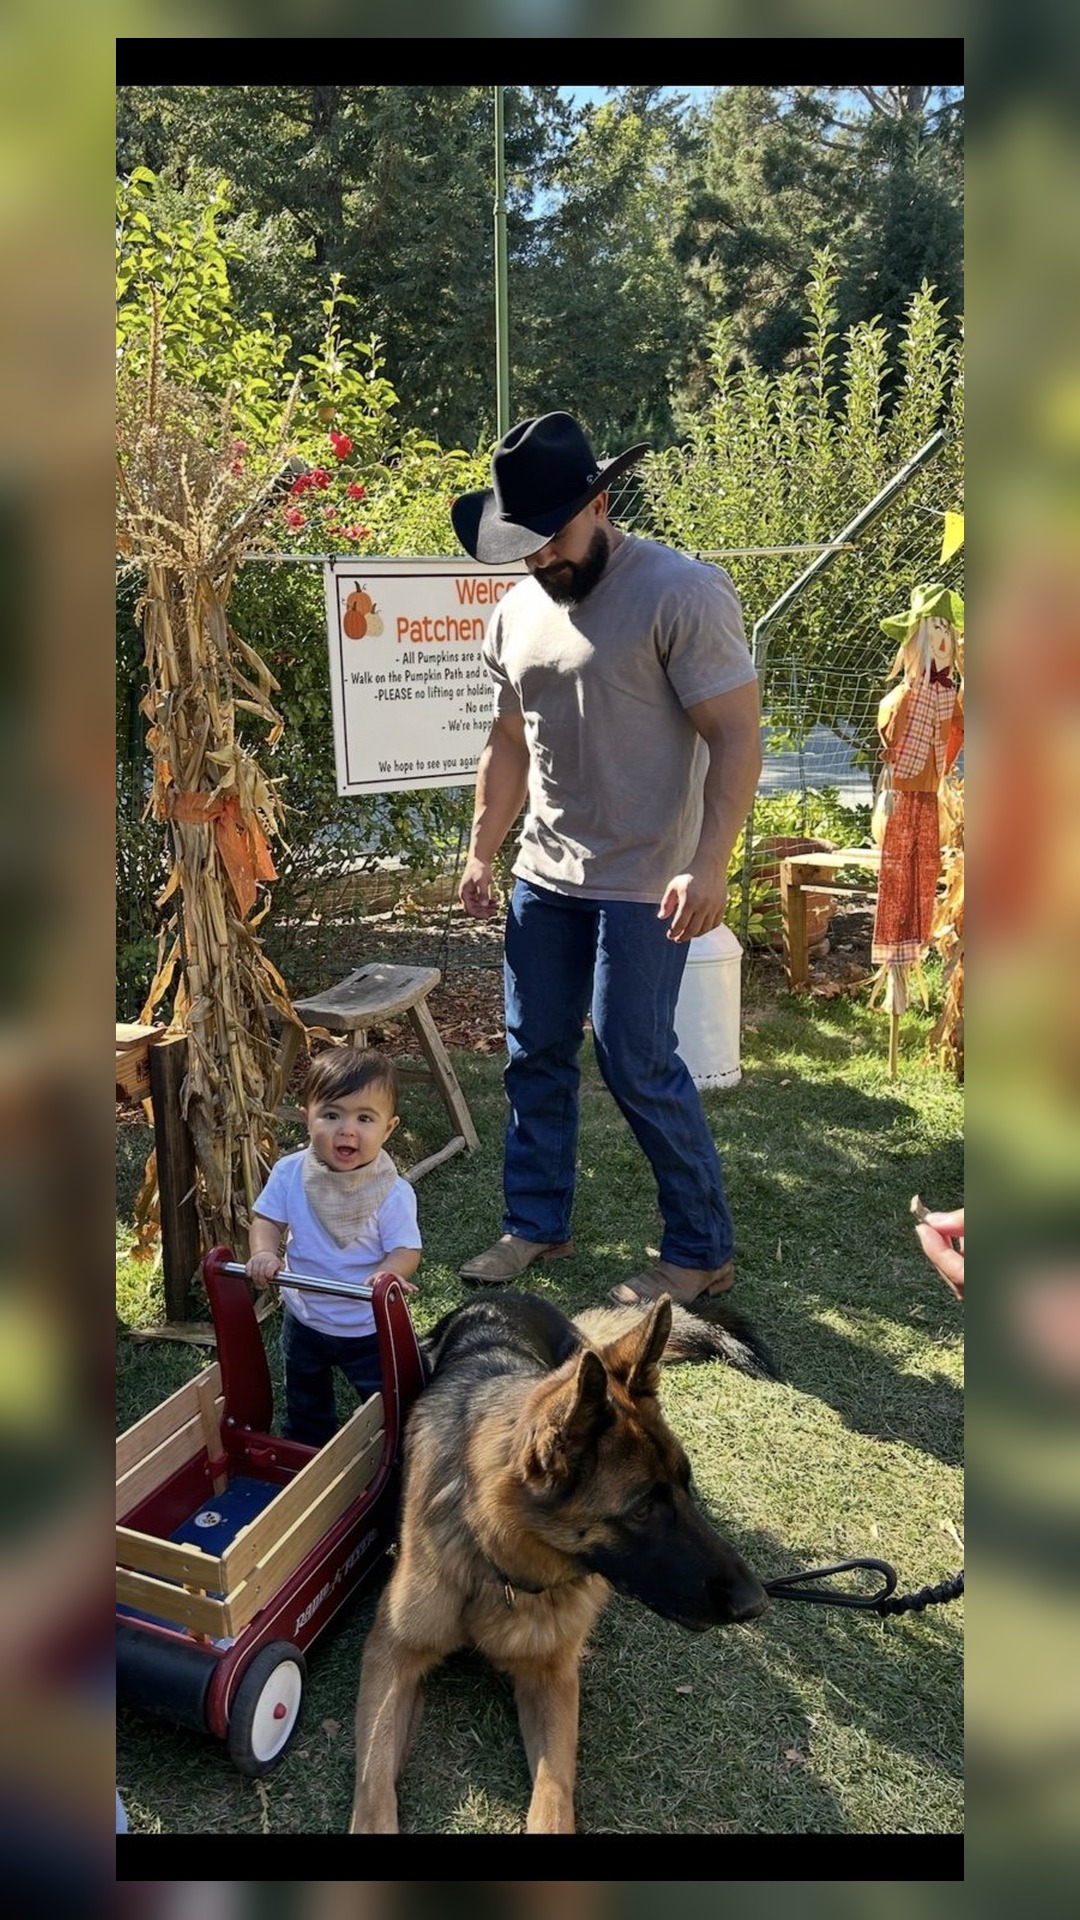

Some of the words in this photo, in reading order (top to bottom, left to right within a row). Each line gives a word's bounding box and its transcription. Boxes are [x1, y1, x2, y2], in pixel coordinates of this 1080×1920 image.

[396, 615, 485, 643] Patchen
[402, 651, 415, 664] All
[418, 650, 459, 666] Pumpkins
[461, 652, 474, 661] are
[351, 671, 374, 684] Walk
[375, 674, 386, 683] on
[388, 670, 402, 683] the
[404, 668, 442, 684] Pumpkin
[444, 667, 464, 680] Path
[466, 665, 480, 679] and
[482, 669, 489, 678] o
[415, 690, 425, 699] no
[427, 685, 454, 700] lifting
[456, 688, 465, 697] or
[465, 701, 477, 713] No
[479, 701, 493, 712] ent
[448, 719, 471, 731] We're
[472, 718, 492, 732] happ
[378, 760, 391, 773] We
[393, 759, 414, 774] hope
[416, 759, 425, 770] to
[426, 760, 440, 769] see
[442, 758, 457, 771] you
